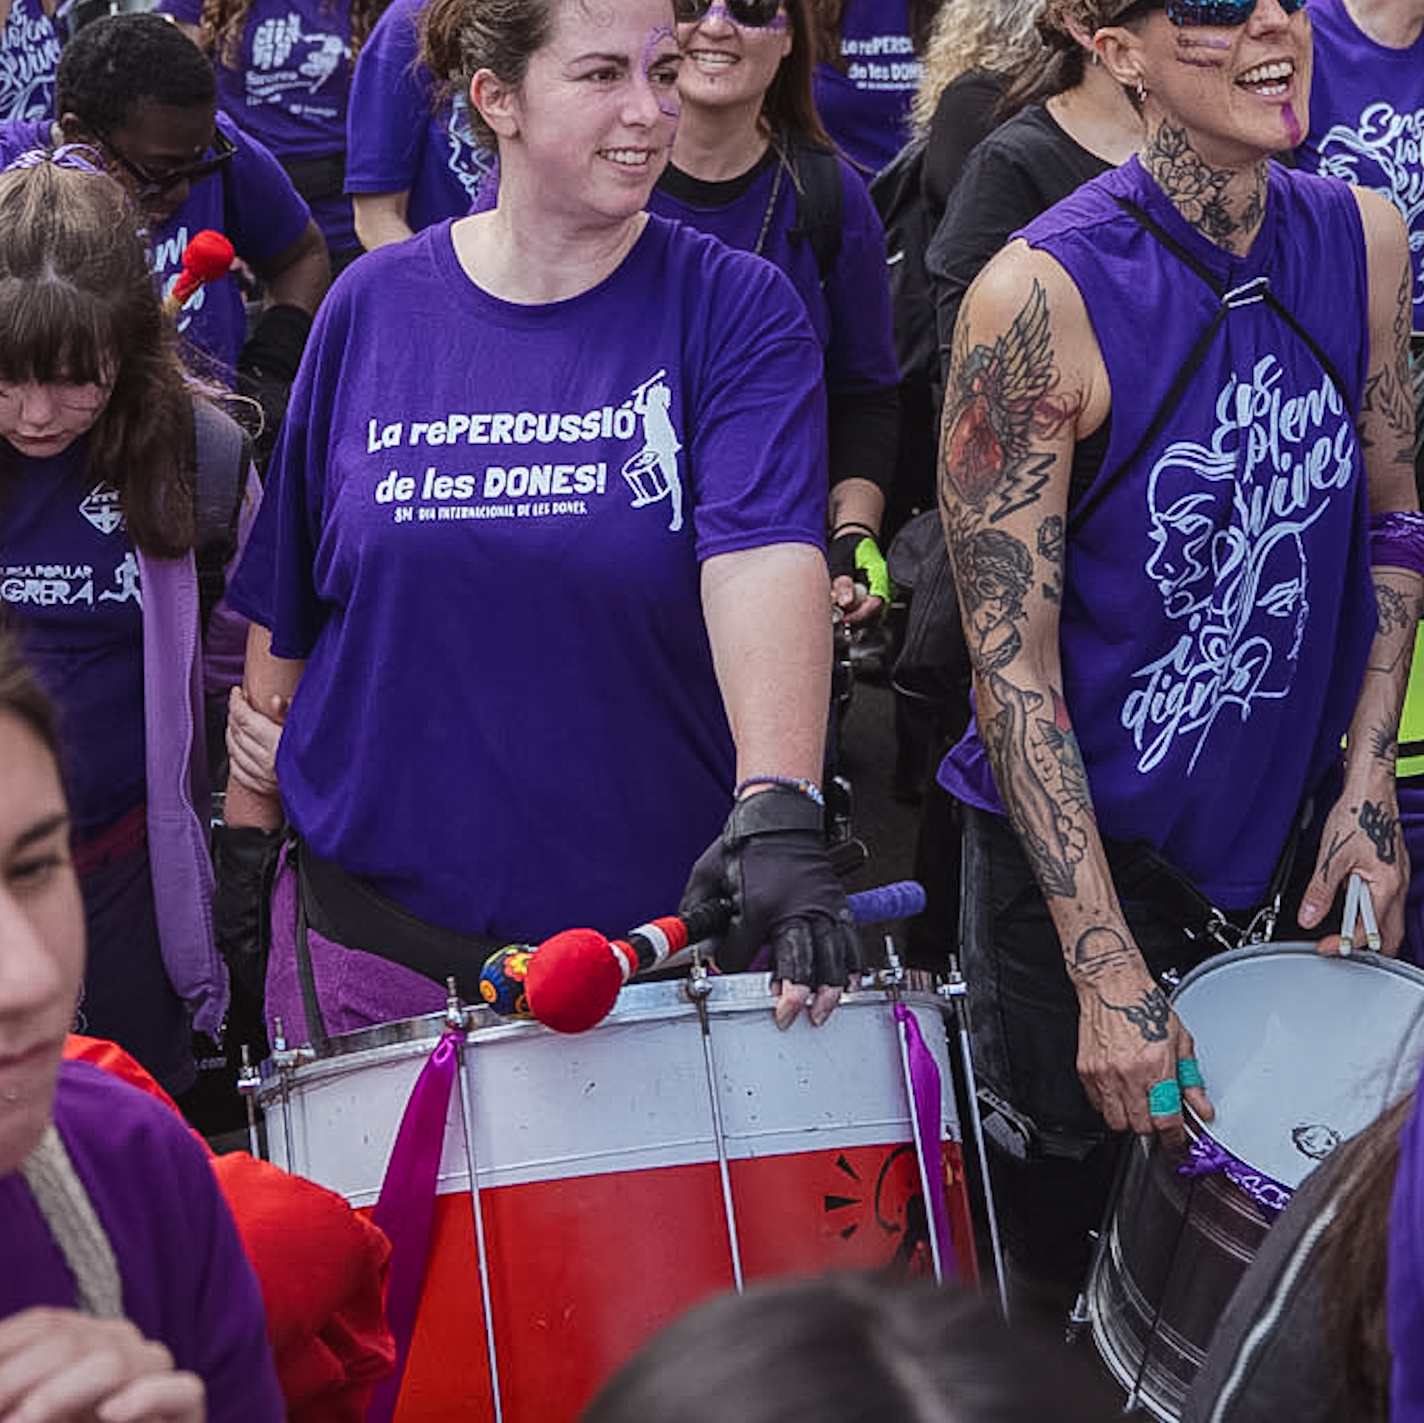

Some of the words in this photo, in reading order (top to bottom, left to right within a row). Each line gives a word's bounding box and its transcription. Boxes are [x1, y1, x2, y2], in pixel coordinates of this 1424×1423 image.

[366, 418, 403, 454] La
[409, 400, 636, 446] rePERCUSSIÓ
[375, 470, 416, 503] de
[422, 467, 476, 500] les
[483, 462, 608, 498] DONES!
